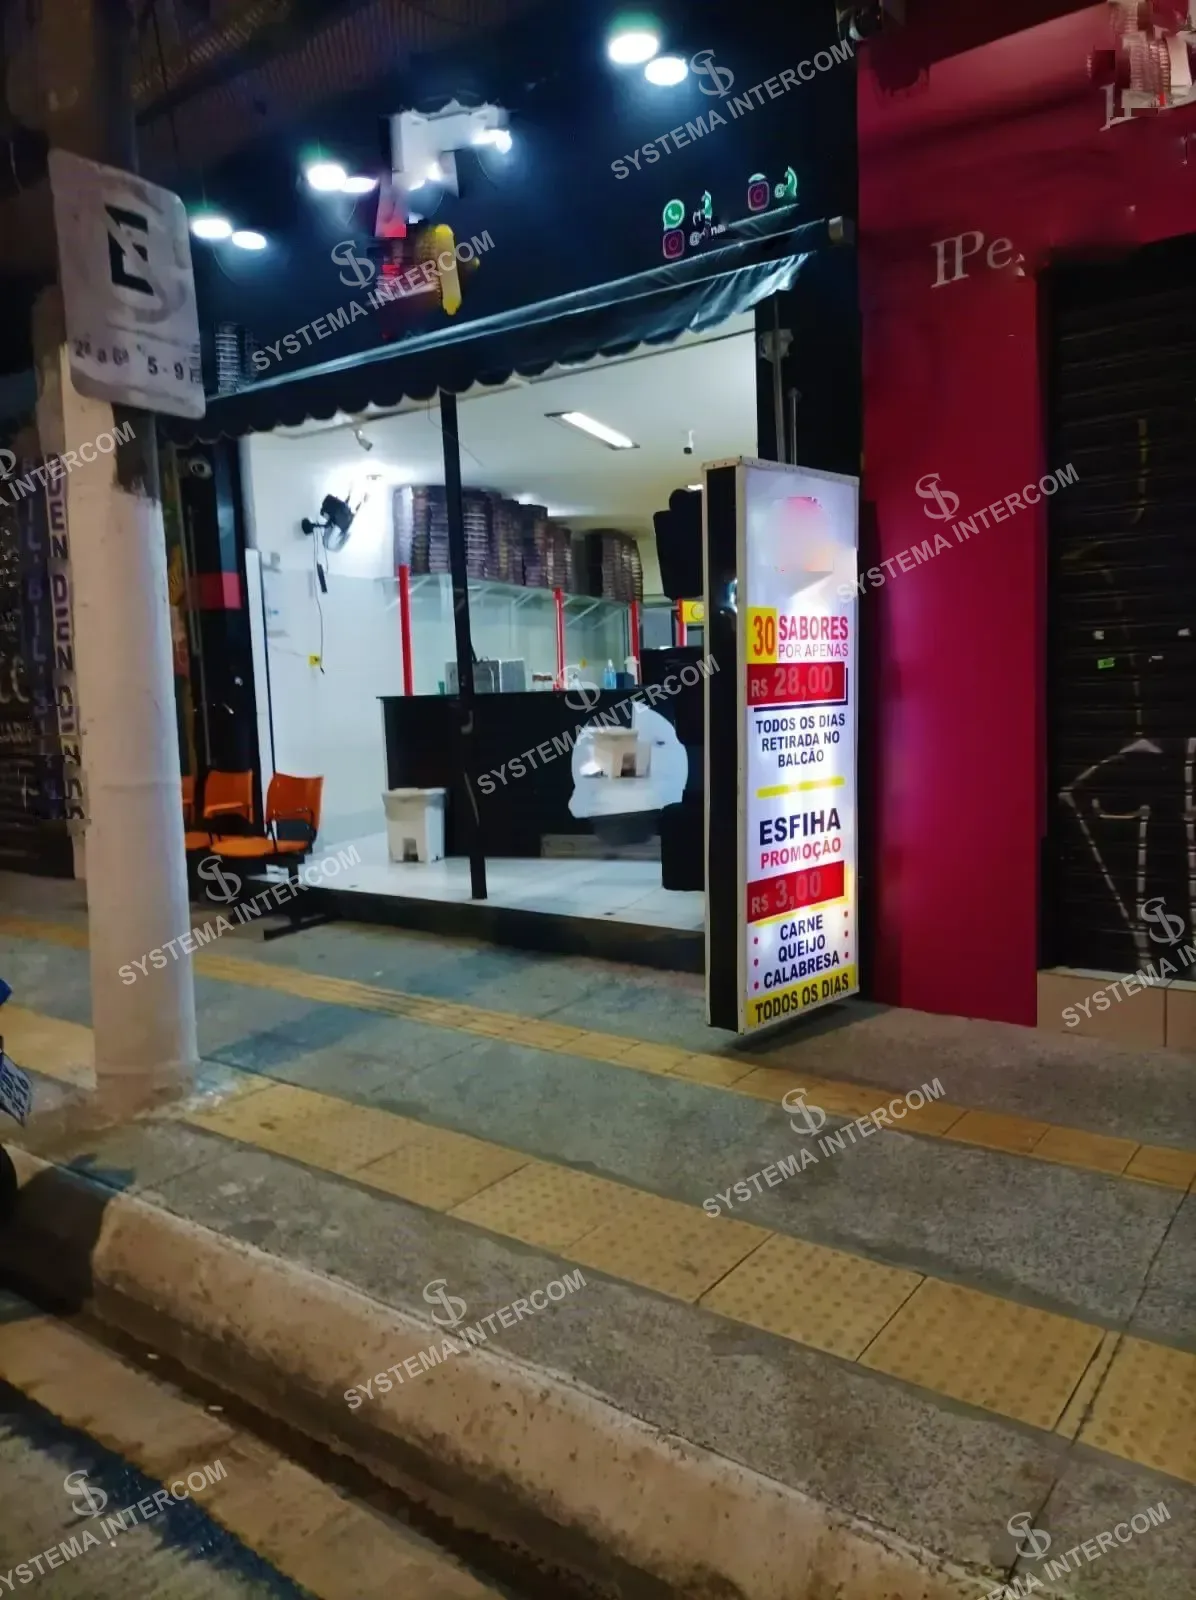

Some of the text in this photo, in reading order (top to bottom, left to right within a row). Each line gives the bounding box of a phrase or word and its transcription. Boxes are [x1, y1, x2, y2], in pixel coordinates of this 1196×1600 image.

[752, 615, 849, 656] 30 SABORES
[778, 643, 849, 658] POR APENAS
[751, 665, 833, 700] R$ 28,00
[756, 713, 845, 734] TODOS OS DIAS
[761, 730, 840, 752] RETIRADA NO
[778, 747, 824, 768] BALCÃO
[759, 808, 841, 846] ESFIHA
[761, 835, 842, 869] PROMOÇÃO
[751, 870, 822, 915] R$ 3,00
[780, 914, 823, 940] CARNE
[778, 934, 826, 962] QUEIJO
[763, 950, 840, 988] CALABRESA
[755, 972, 849, 1023] TODOS OS DIAS
